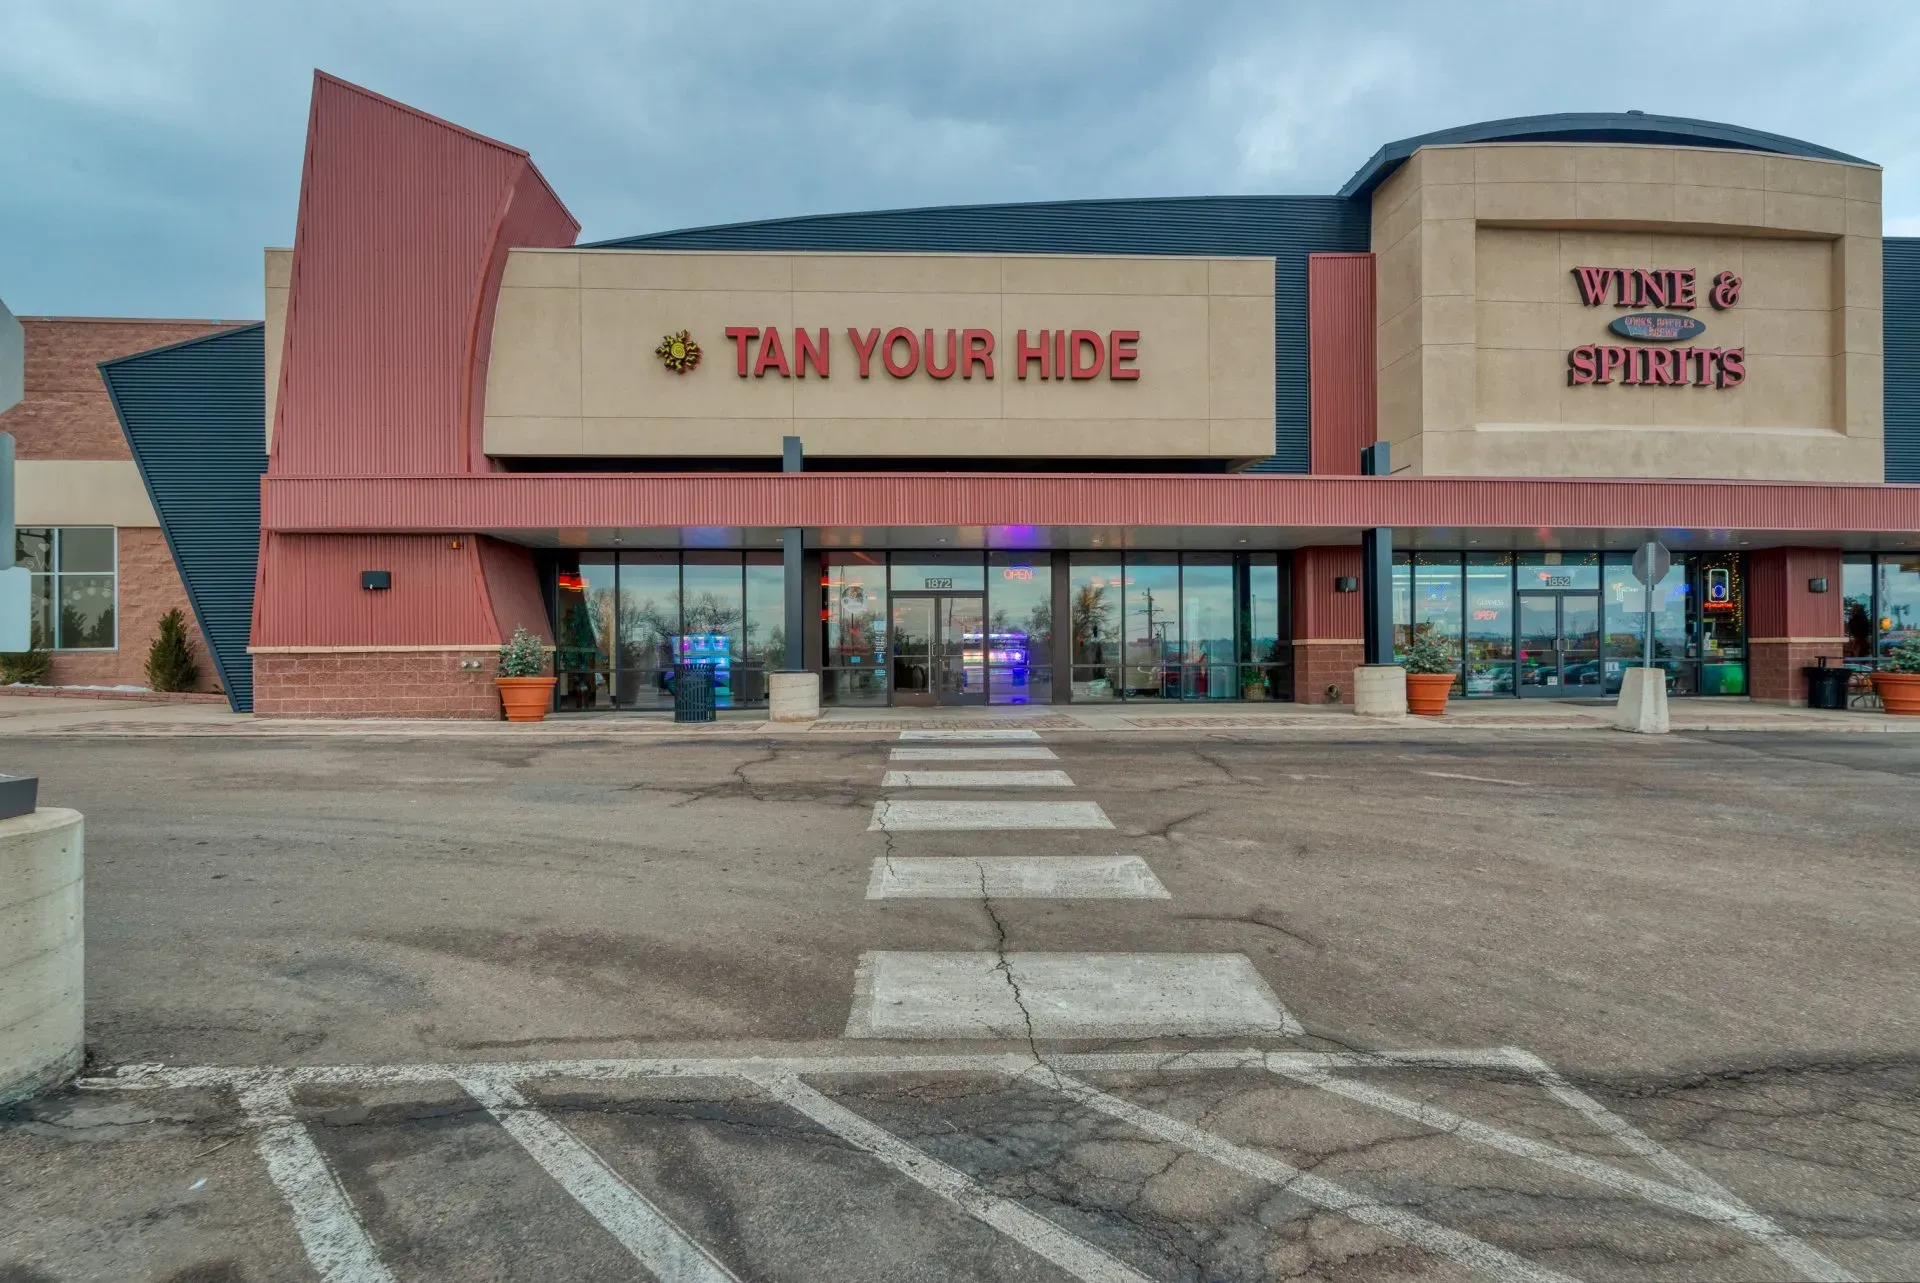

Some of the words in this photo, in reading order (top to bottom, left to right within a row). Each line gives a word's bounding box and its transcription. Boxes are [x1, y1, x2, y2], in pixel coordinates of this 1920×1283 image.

[1571, 267, 1697, 311] WINE
[1709, 271, 1742, 310] &
[725, 326, 830, 379] TAN
[847, 327, 995, 380] YOUR
[1017, 328, 1140, 381] HIDE
[1567, 344, 1746, 389] SPIRITS
[1003, 568, 1033, 581] OPEN
[926, 578, 951, 588] 1872
[1547, 577, 1570, 586] 1852
[1473, 610, 1498, 620] OPEN
